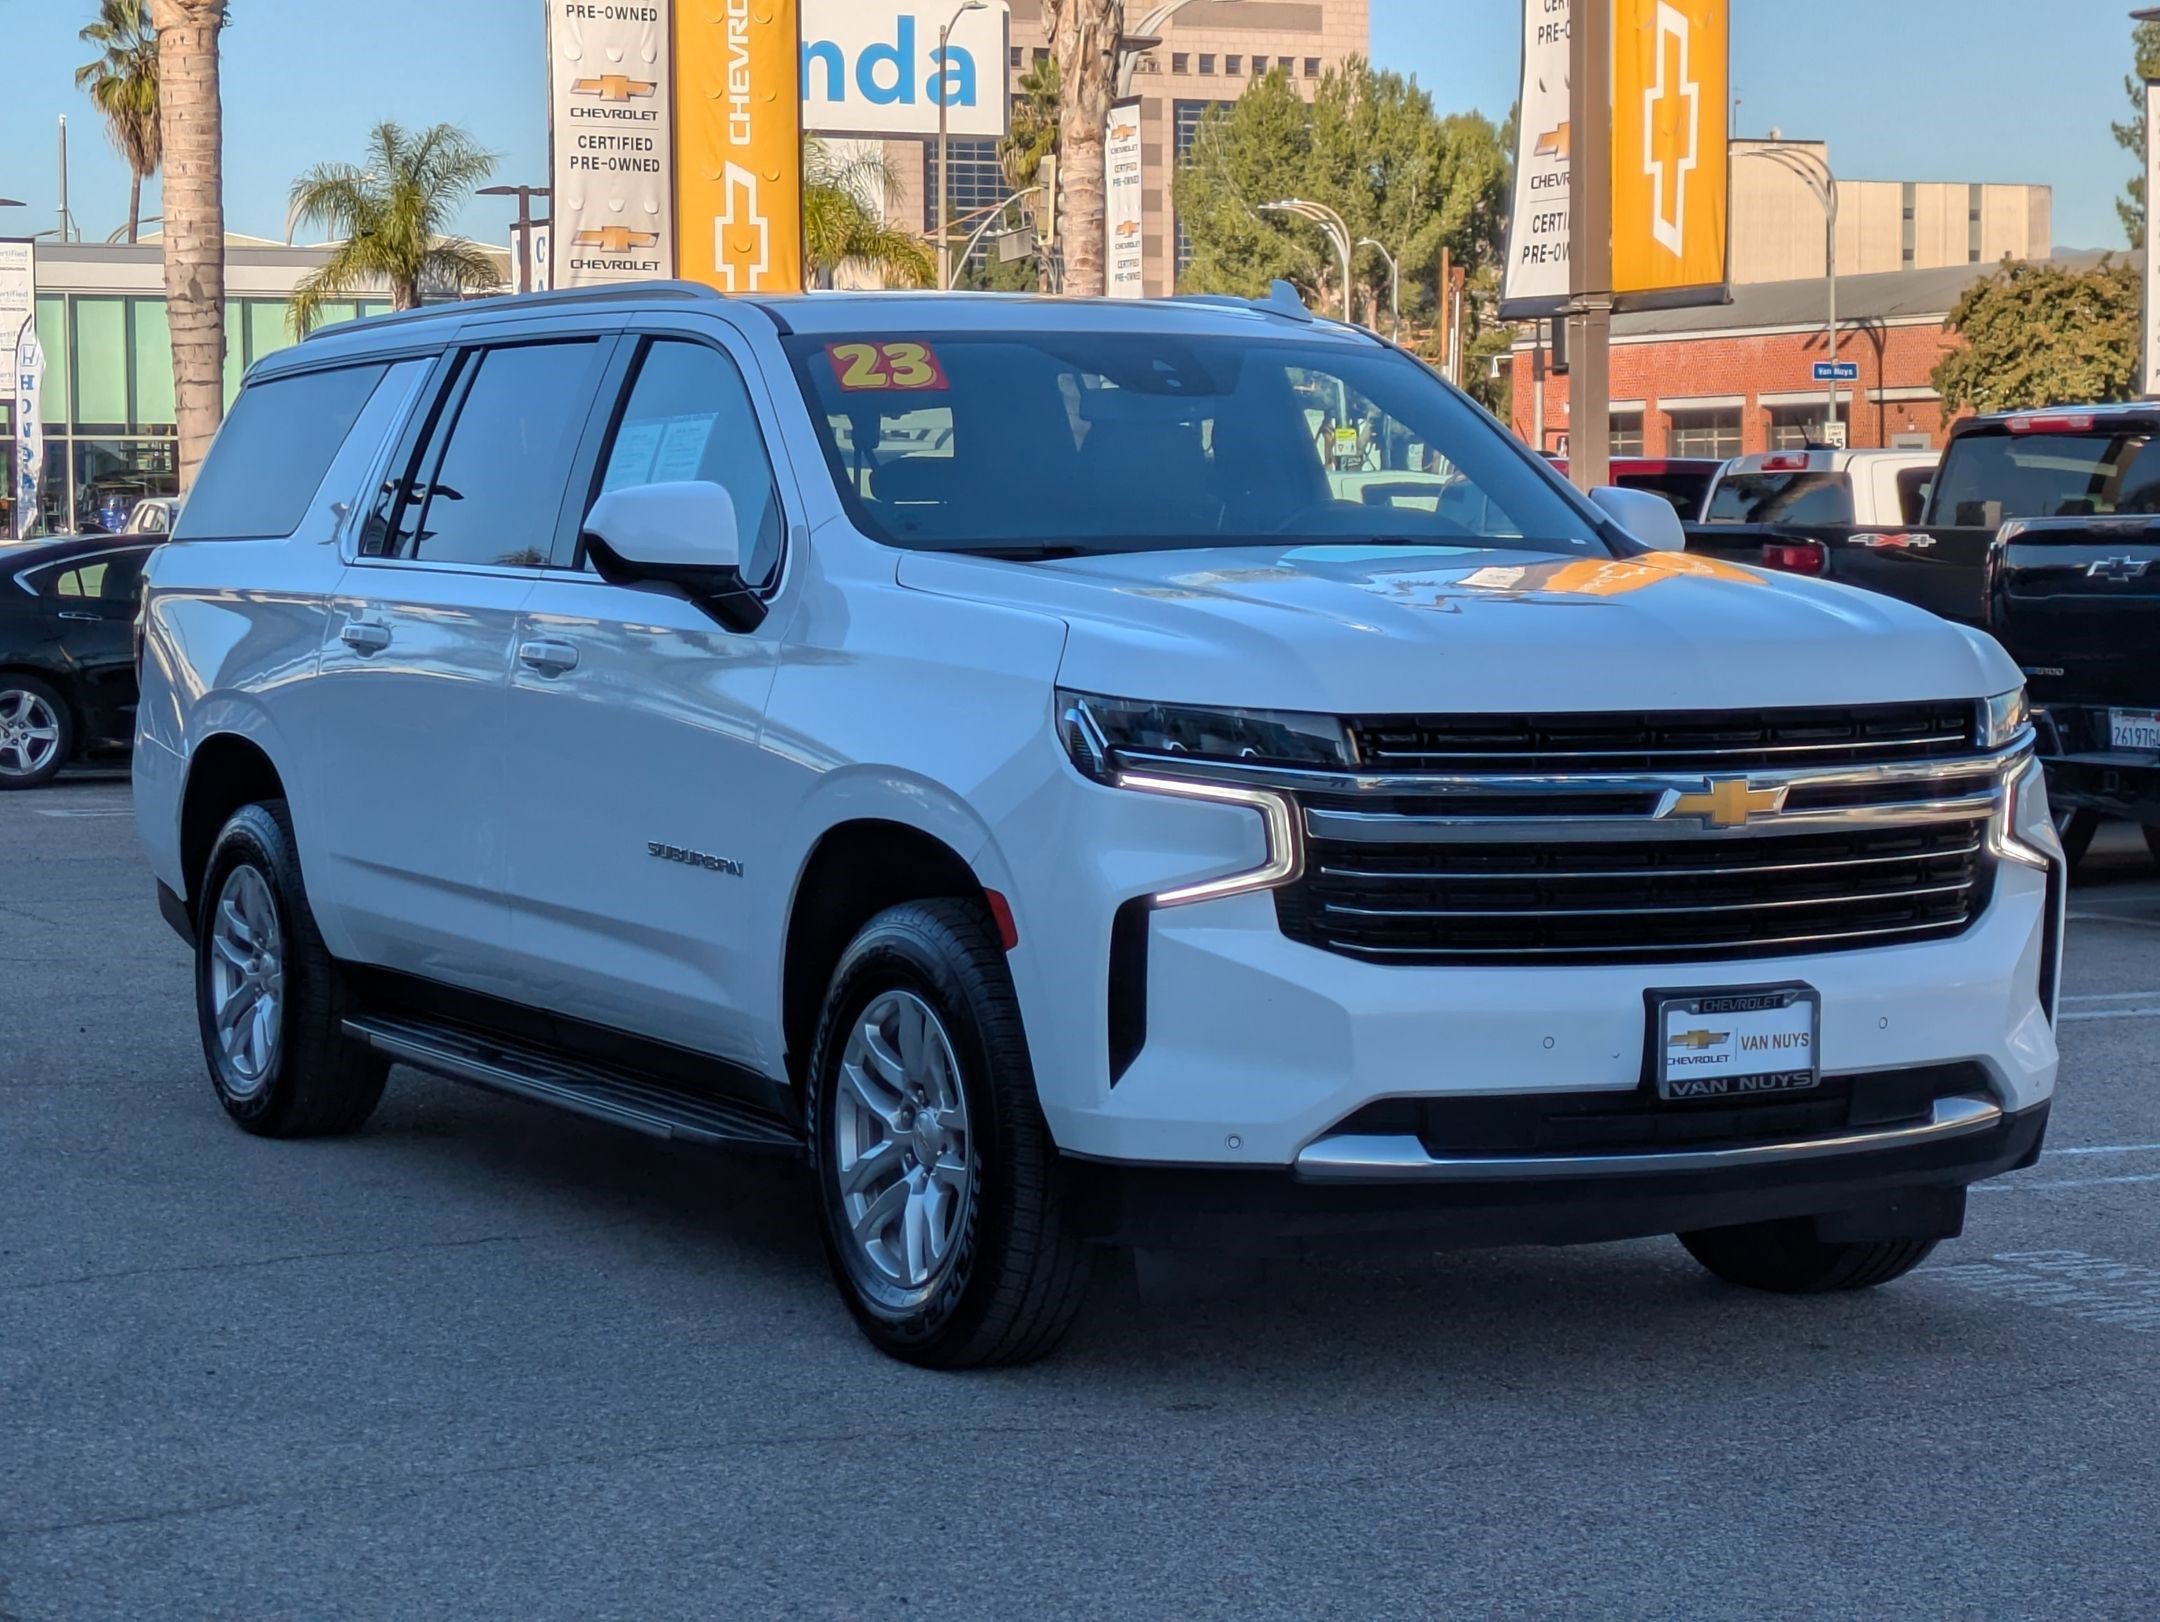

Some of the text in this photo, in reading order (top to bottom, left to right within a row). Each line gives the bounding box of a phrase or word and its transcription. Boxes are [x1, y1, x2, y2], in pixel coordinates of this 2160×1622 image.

[566, 4, 658, 22] PRE-OWNED
[570, 107, 659, 121] CHEVROLET
[577, 135, 653, 151] CERTIFIED
[570, 156, 660, 173] PRE-OWNED
[1532, 211, 1571, 234] CERTI
[570, 259, 660, 271] CHEVROLET
[832, 343, 937, 388] 23
[1818, 367, 1853, 377] Van Nuys
[647, 840, 744, 877] SUBURBAN
[1703, 995, 1780, 1012] CHEVROLET
[1741, 1032, 1809, 1050] VAN NUYS
[1671, 1071, 1812, 1097] VAN NUYS
